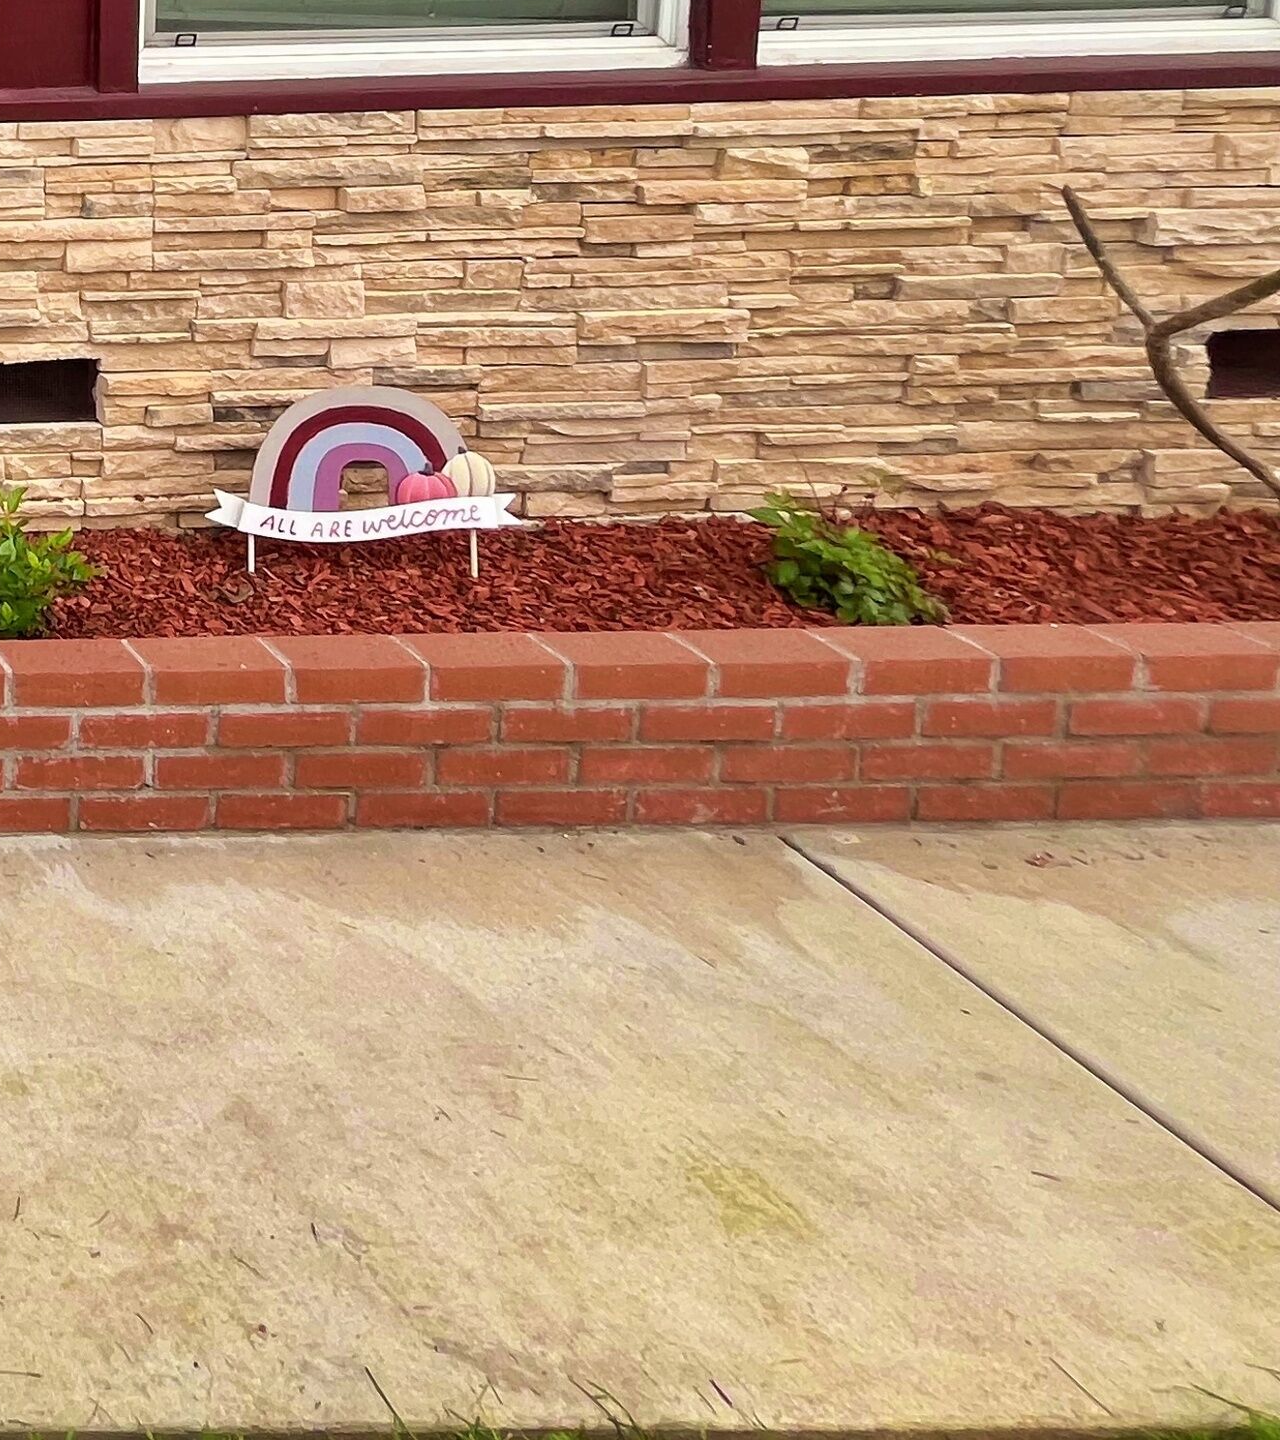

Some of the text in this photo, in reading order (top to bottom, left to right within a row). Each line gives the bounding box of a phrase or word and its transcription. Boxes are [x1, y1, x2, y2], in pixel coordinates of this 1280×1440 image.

[259, 504, 482, 538] ALL ARE welcome
